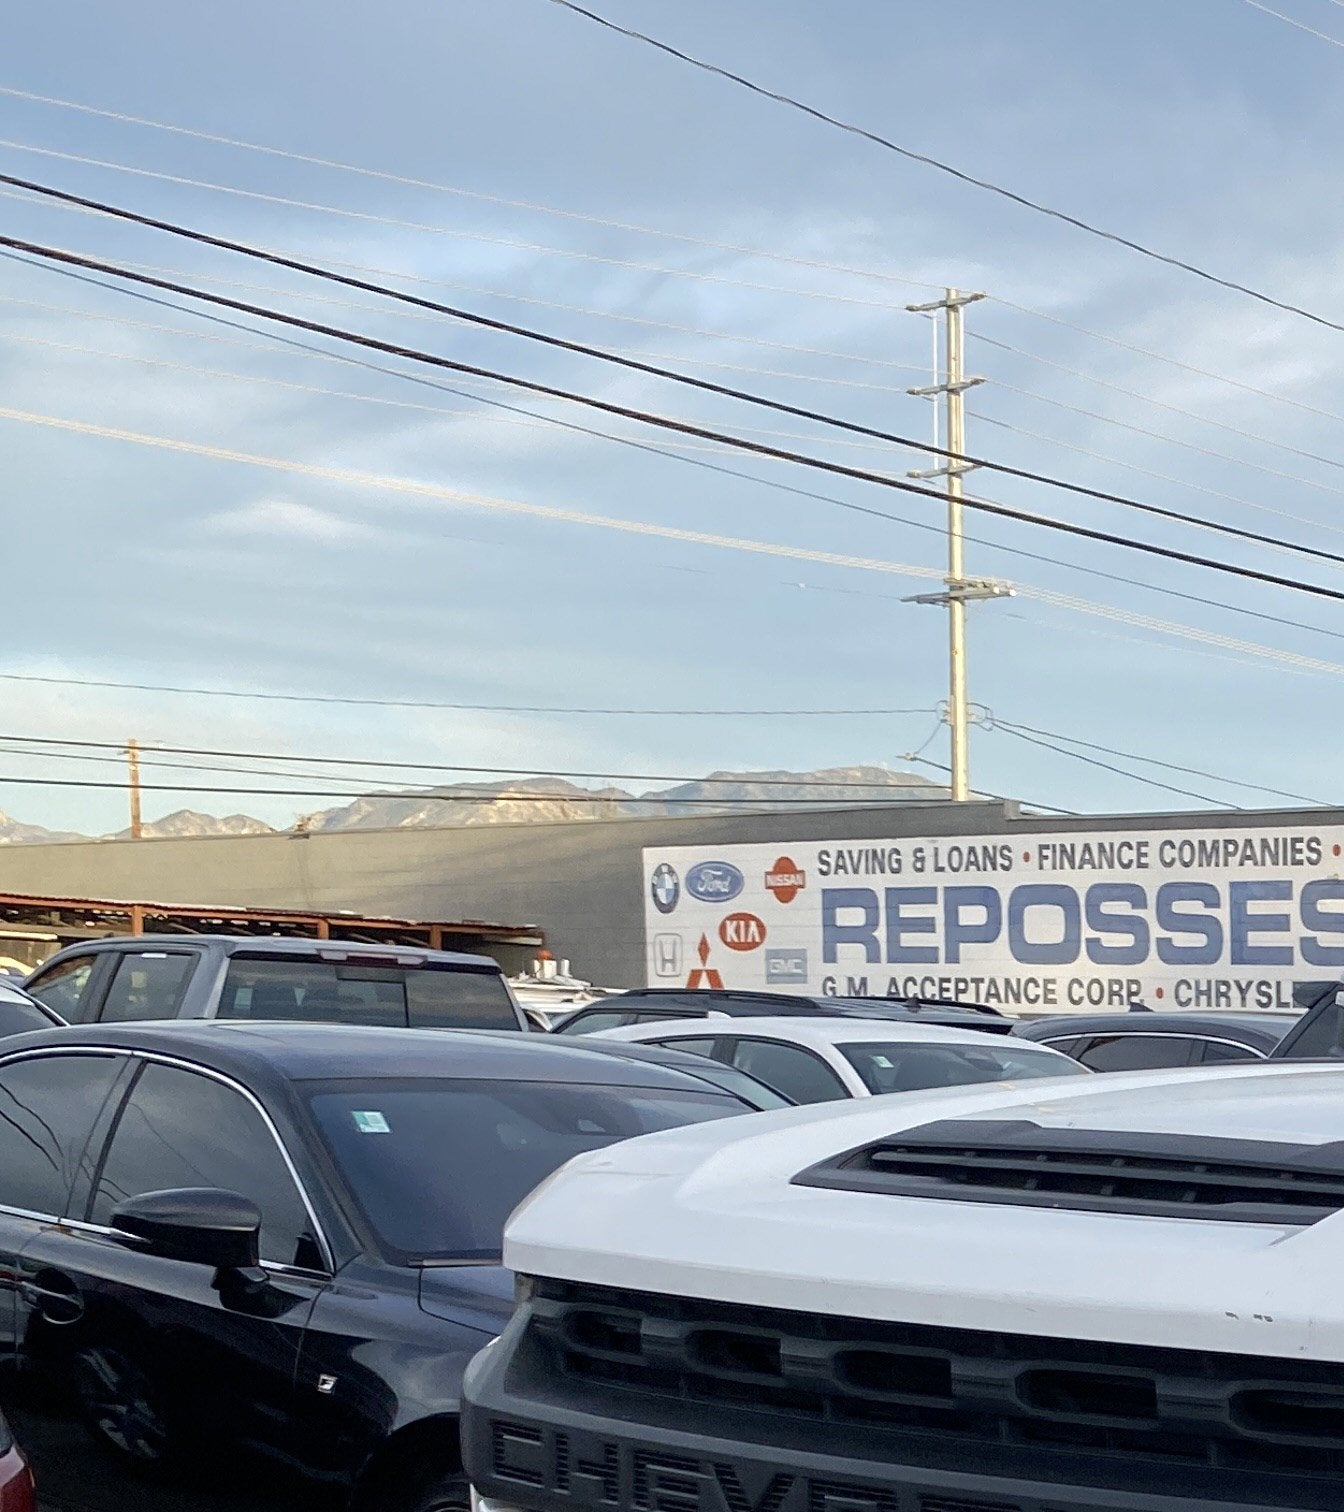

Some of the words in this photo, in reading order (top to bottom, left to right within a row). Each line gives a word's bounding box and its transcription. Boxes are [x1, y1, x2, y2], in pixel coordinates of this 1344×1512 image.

[817, 848, 902, 876] SAVING
[912, 847, 926, 873] &
[933, 844, 1013, 873] LOANS
[1037, 840, 1150, 871] FINANCE
[1158, 836, 1323, 869] COMPANIES
[725, 919, 761, 943] KIA
[886, 975, 1058, 1005] ACCEPTANCE
[1174, 979, 1302, 1009] CHRYSL
